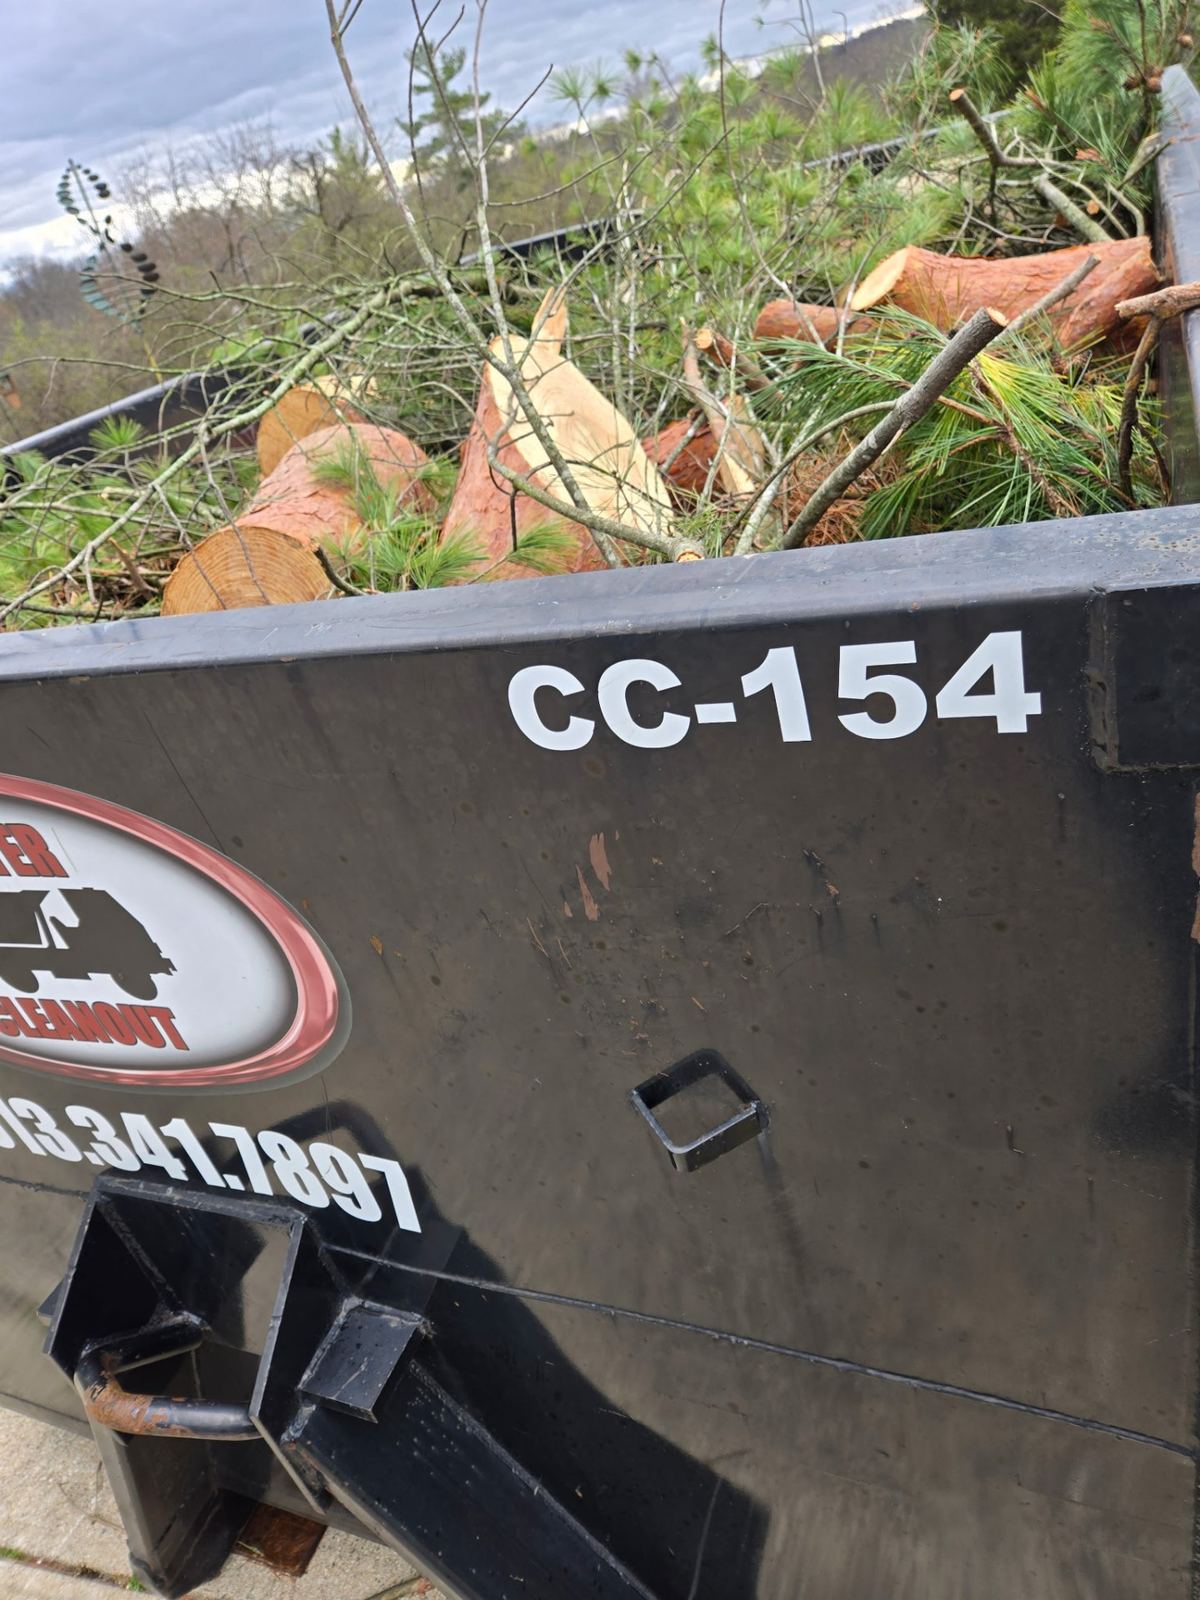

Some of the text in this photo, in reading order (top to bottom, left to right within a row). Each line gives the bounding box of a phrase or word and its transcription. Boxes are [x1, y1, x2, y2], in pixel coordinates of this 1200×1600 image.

[508, 630, 1042, 751] CC-154
[0, 823, 70, 877] ER
[0, 1097, 422, 1234] 13.341.7897
